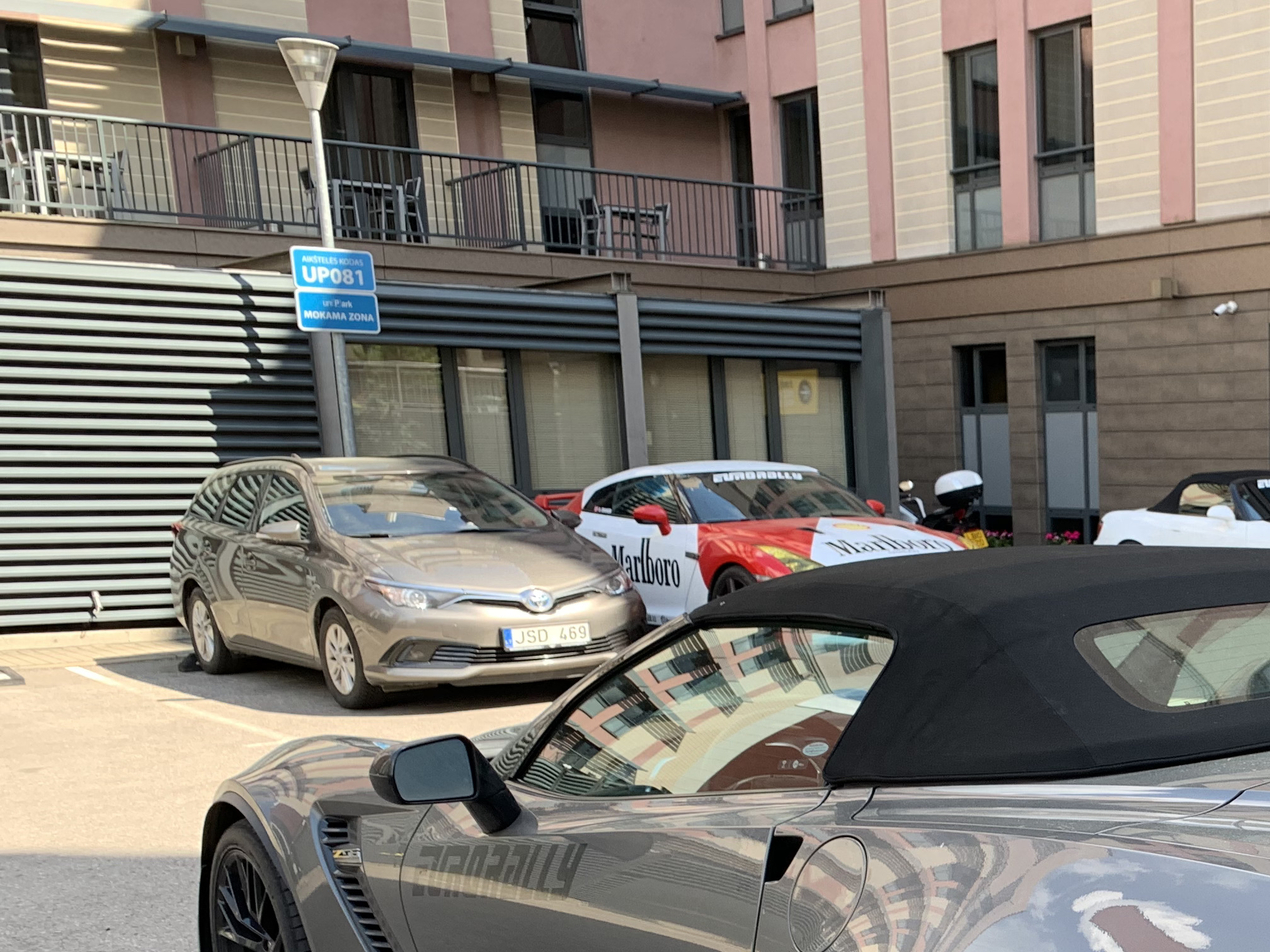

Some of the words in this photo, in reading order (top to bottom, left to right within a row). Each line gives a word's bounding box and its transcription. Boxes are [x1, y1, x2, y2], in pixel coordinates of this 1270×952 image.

[339, 258, 364, 267] KODAS
[302, 265, 364, 286] UP081
[304, 310, 347, 321] MOKAMA
[348, 312, 375, 322] ZONA
[824, 534, 954, 557] Marlboro
[611, 537, 681, 589] Marlboro
[515, 628, 549, 645] JSD
[559, 625, 587, 641] 469
